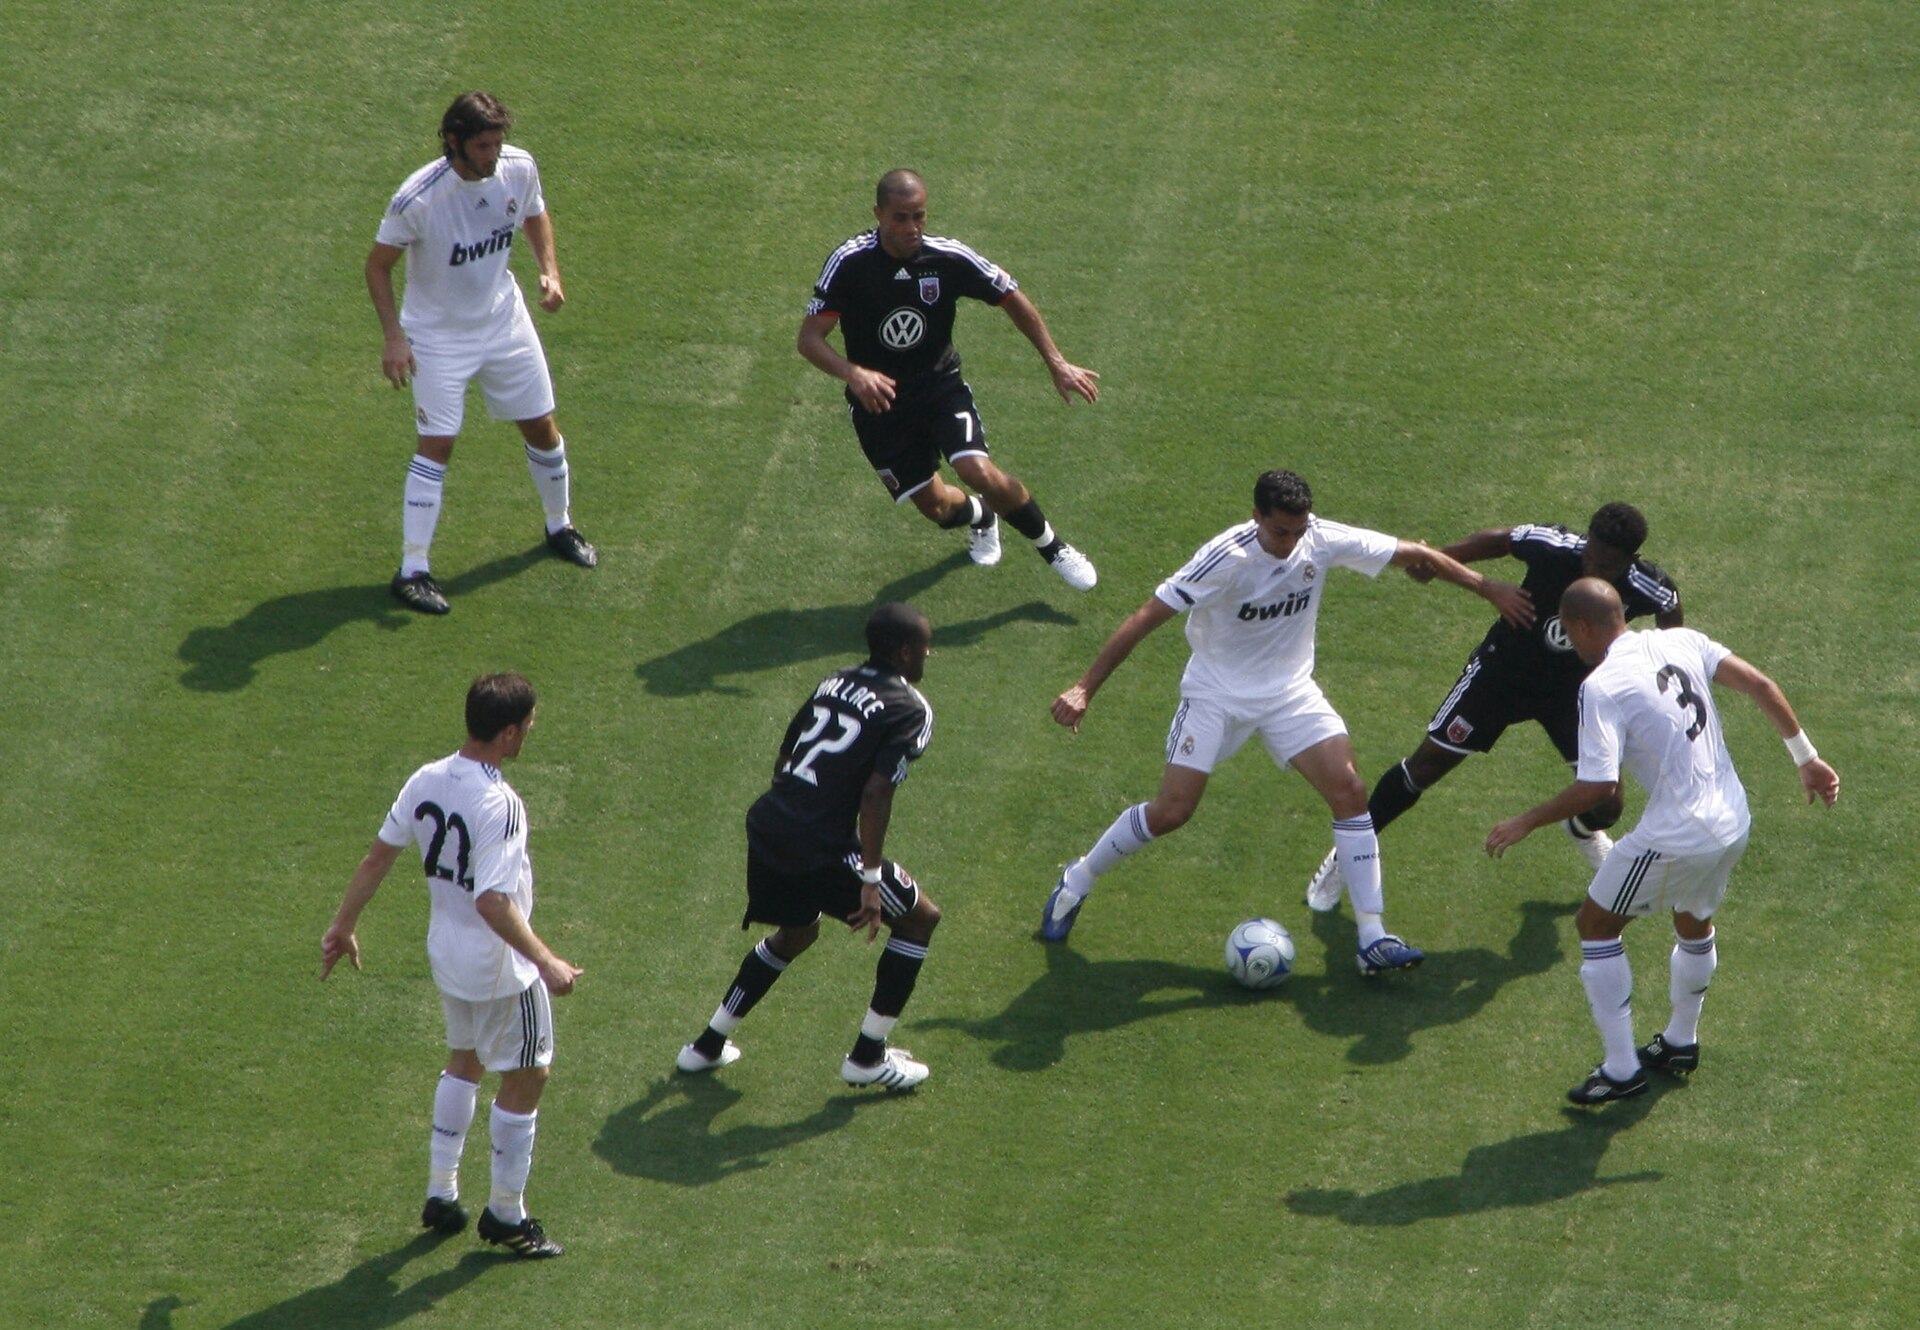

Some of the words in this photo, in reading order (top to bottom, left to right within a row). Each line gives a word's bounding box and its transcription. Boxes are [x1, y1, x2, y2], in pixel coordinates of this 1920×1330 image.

[449, 228, 513, 267] bwin
[954, 411, 973, 442] 7
[1237, 592, 1310, 621] bwin
[813, 677, 885, 720] WALLACE
[1656, 664, 1707, 742] 3
[782, 705, 862, 787] 22
